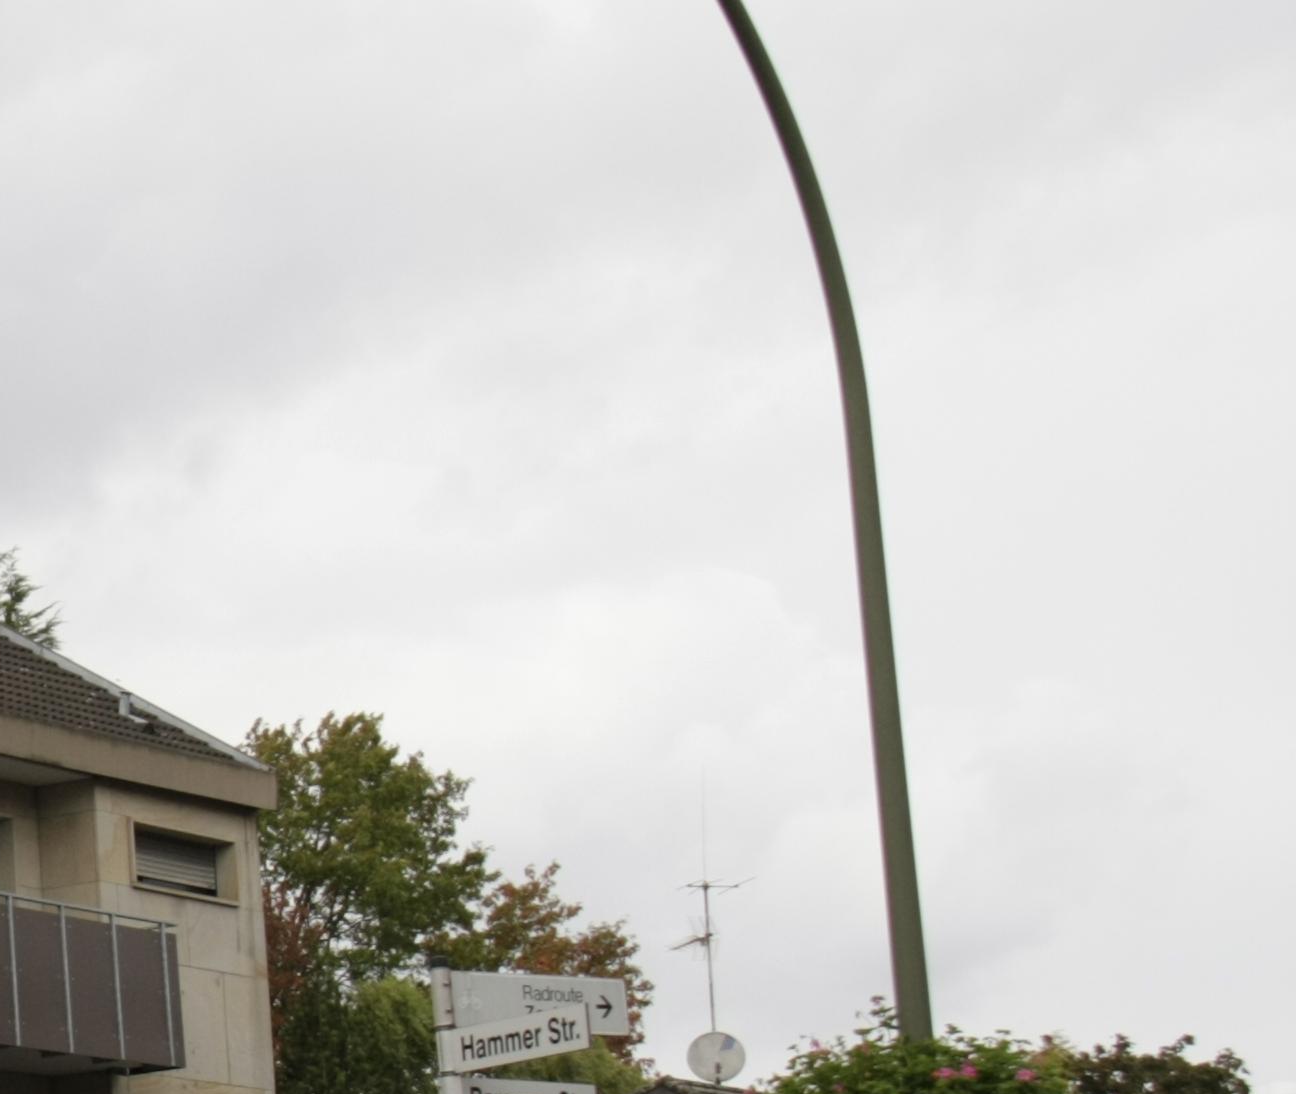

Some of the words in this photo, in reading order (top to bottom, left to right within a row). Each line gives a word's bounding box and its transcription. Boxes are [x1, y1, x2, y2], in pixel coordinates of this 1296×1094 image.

[522, 985, 584, 1003] Radroute
[460, 1027, 541, 1062] Hammer
[548, 1017, 581, 1045] Str.
